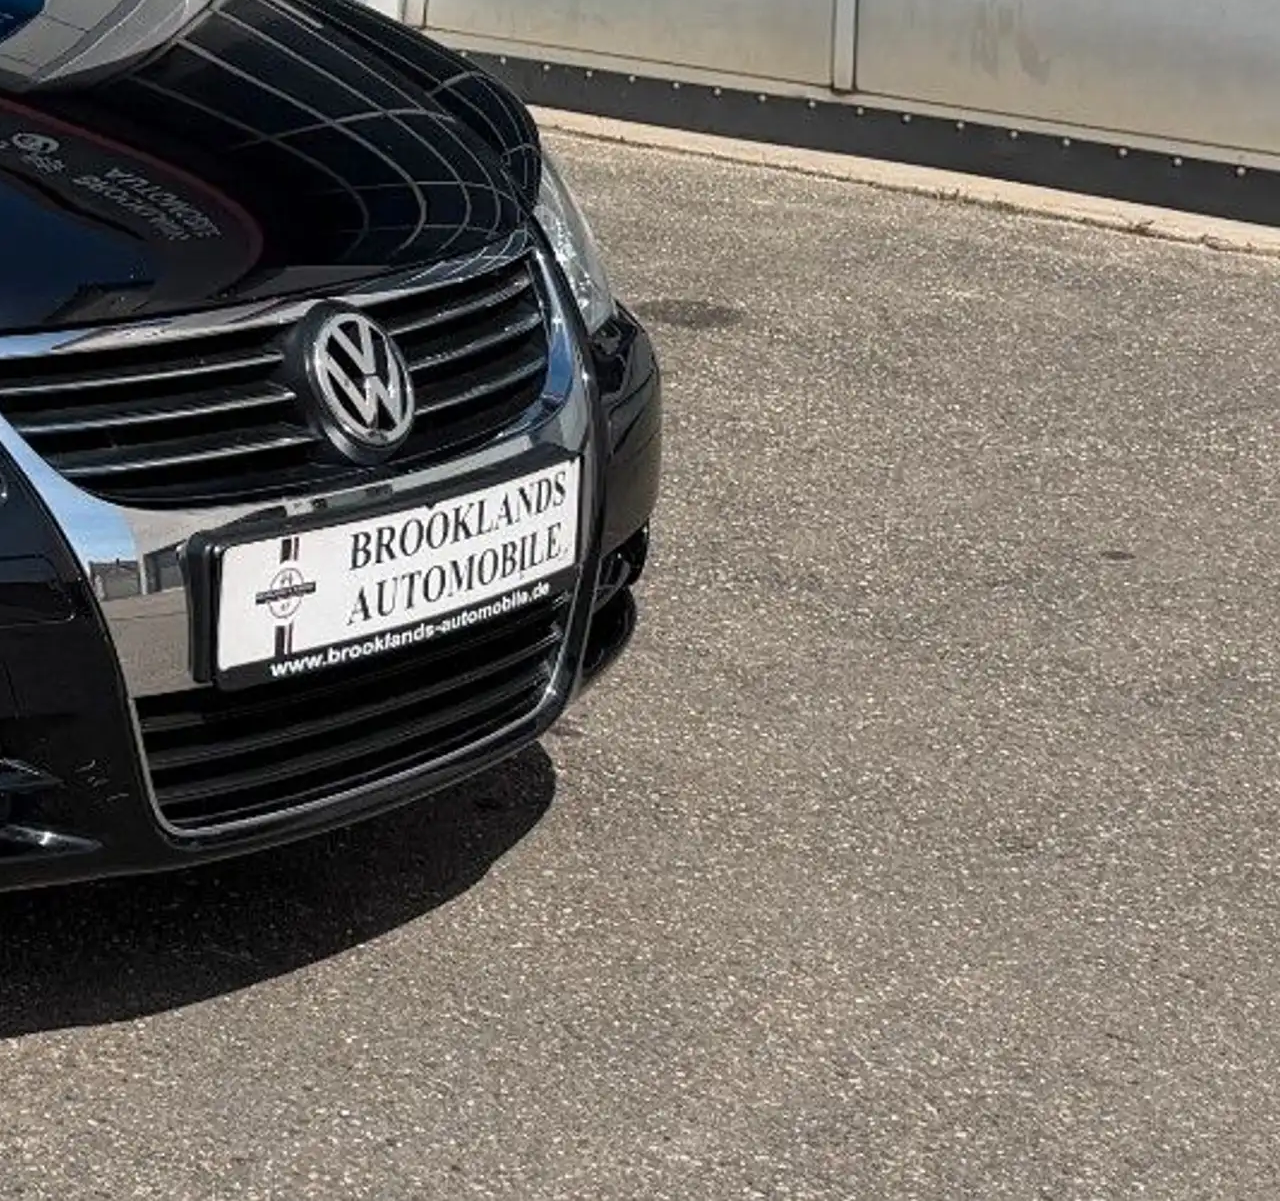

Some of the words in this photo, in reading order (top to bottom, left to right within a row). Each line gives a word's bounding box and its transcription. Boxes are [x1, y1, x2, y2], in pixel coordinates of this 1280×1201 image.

[349, 470, 567, 571] BROOKLANDS
[346, 521, 563, 627] AUTOMOBILE
[269, 581, 552, 679] www.brooklands-automobile.de
